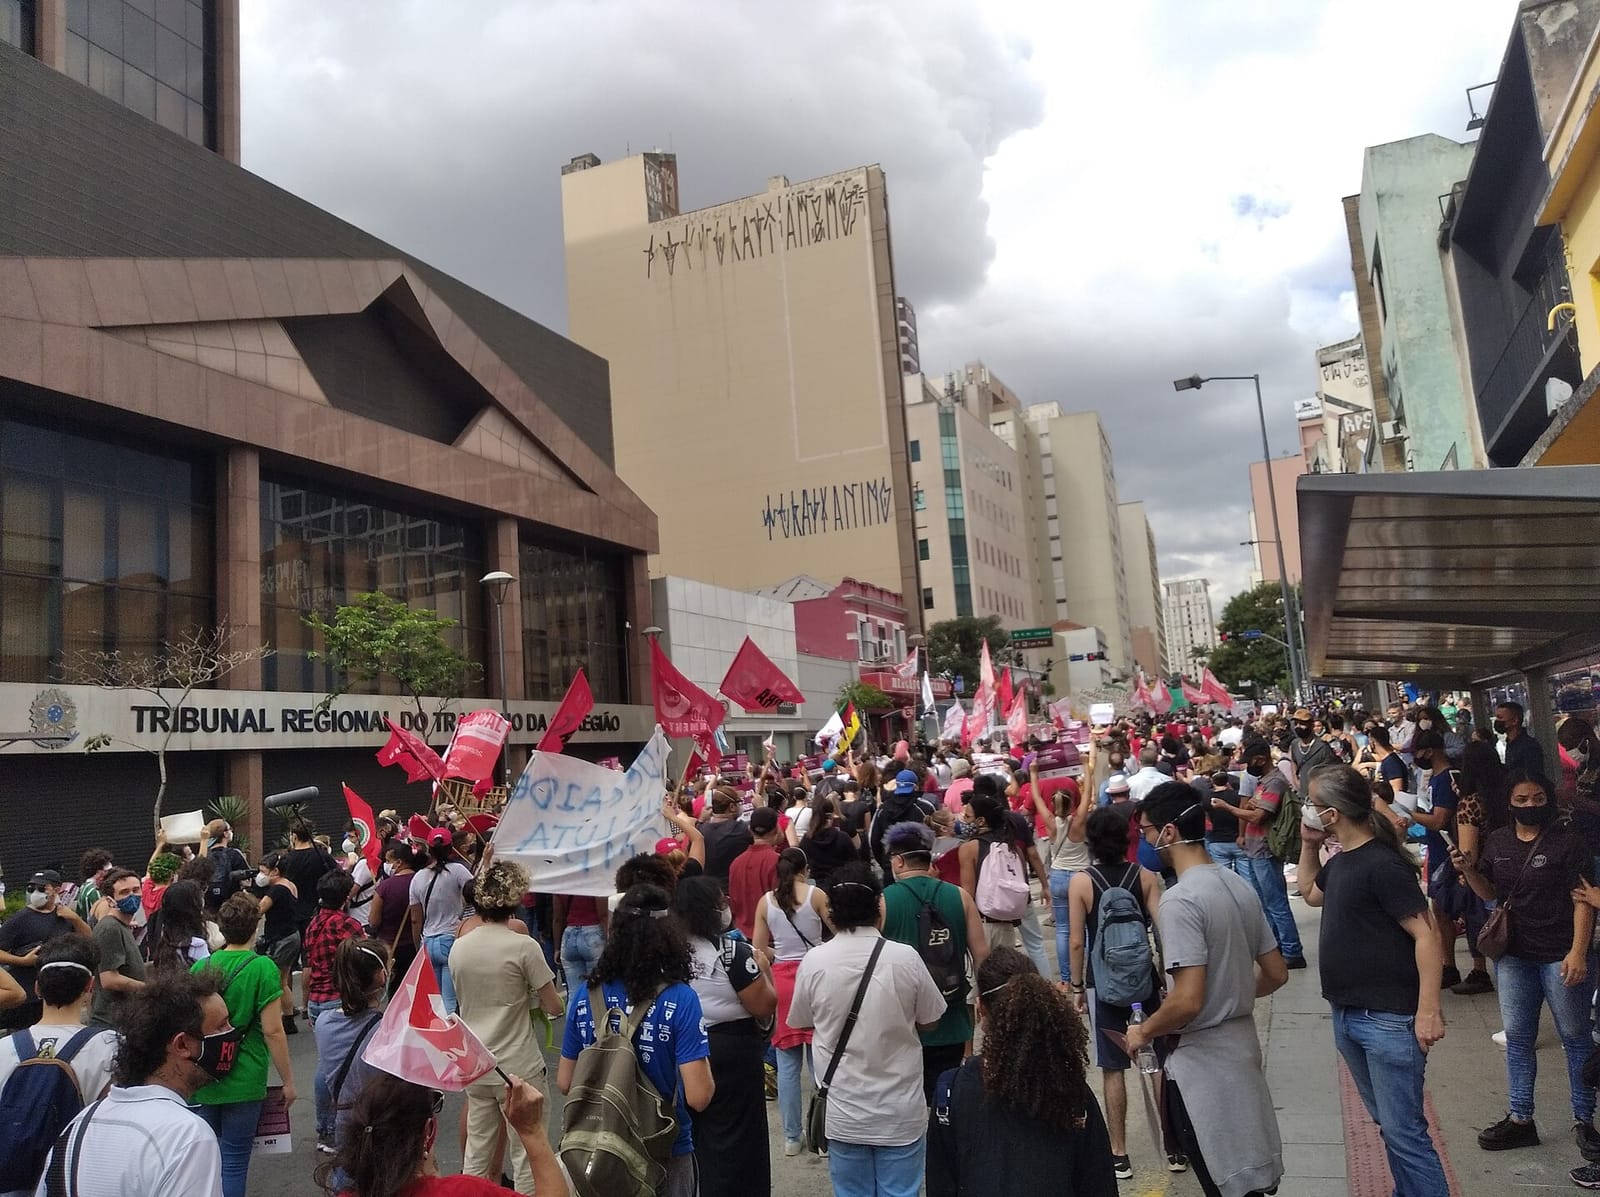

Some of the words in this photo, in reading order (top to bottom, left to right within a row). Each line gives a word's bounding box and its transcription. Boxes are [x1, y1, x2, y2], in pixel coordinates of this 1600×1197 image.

[130, 705, 275, 733] TRIBUNAL
[281, 708, 390, 732] REGIONAL
[401, 711, 428, 732] DO
[527, 713, 547, 732] DA
